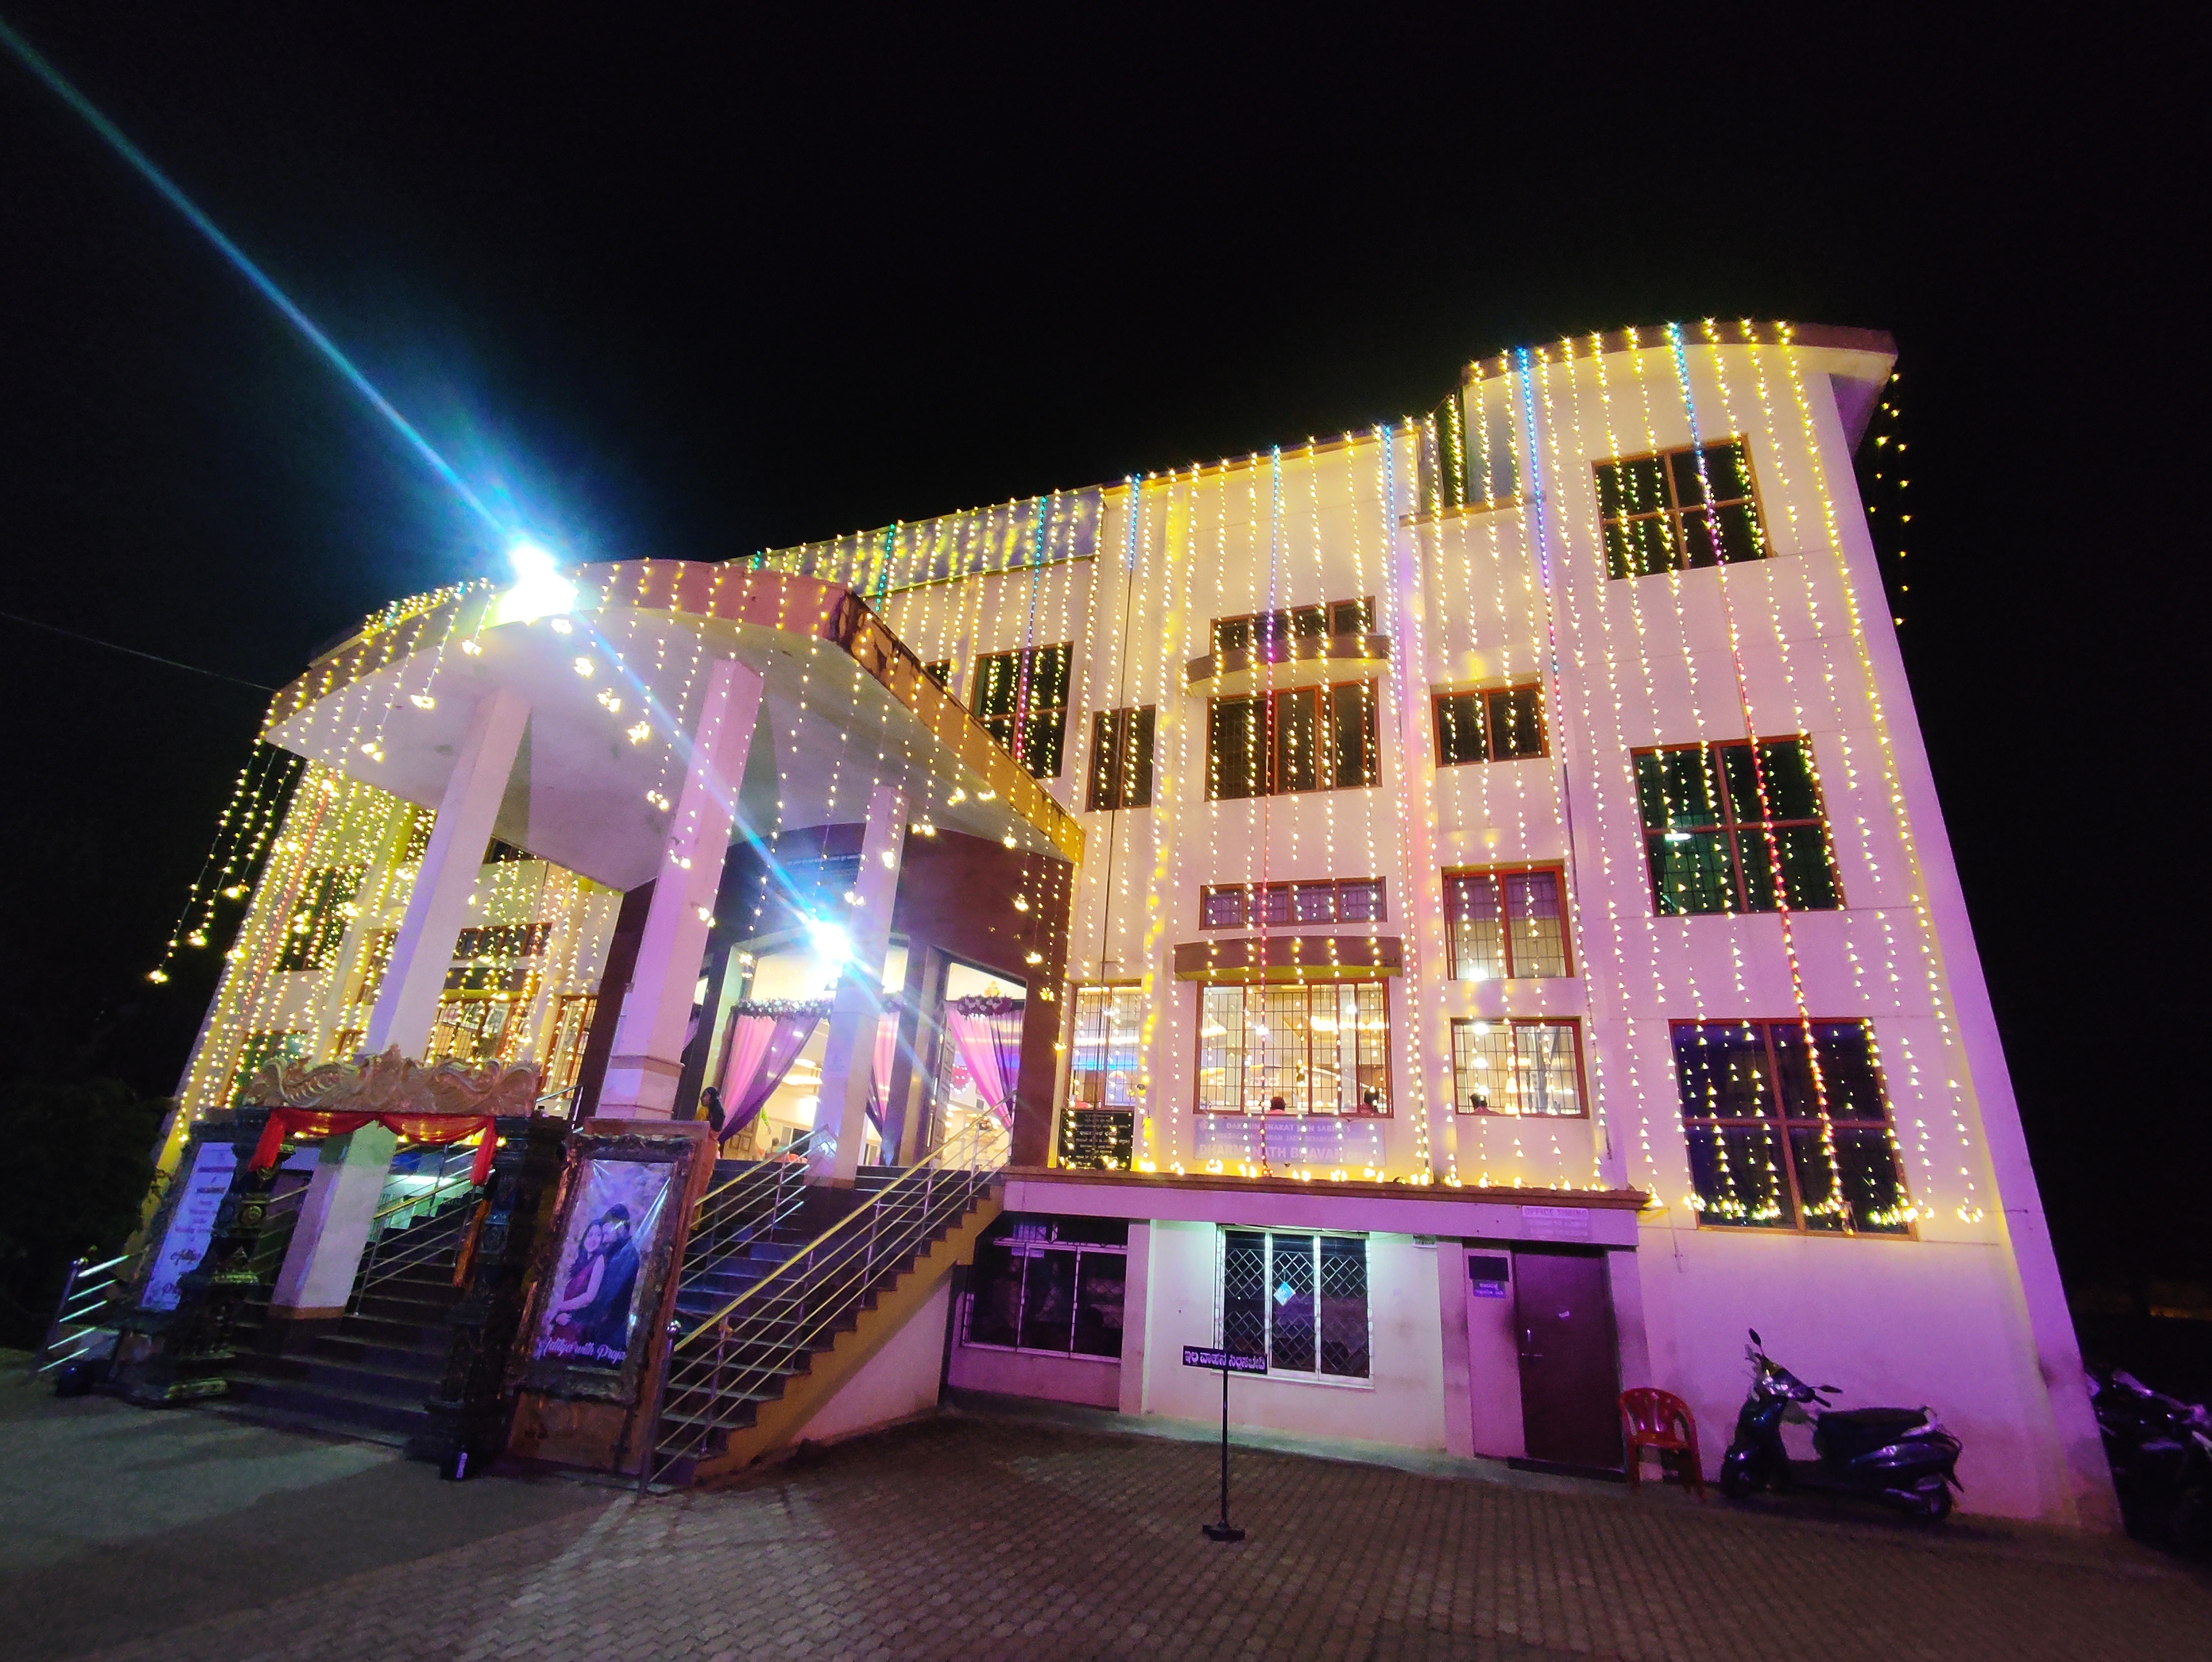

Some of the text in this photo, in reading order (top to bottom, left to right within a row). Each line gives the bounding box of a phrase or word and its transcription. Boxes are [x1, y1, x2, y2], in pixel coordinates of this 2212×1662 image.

[1225, 1122, 1260, 1130] DAKHIN
[1199, 1144, 1286, 1159] DHARMNATH
[1200, 1352, 1227, 1367] ವಾಹನ
